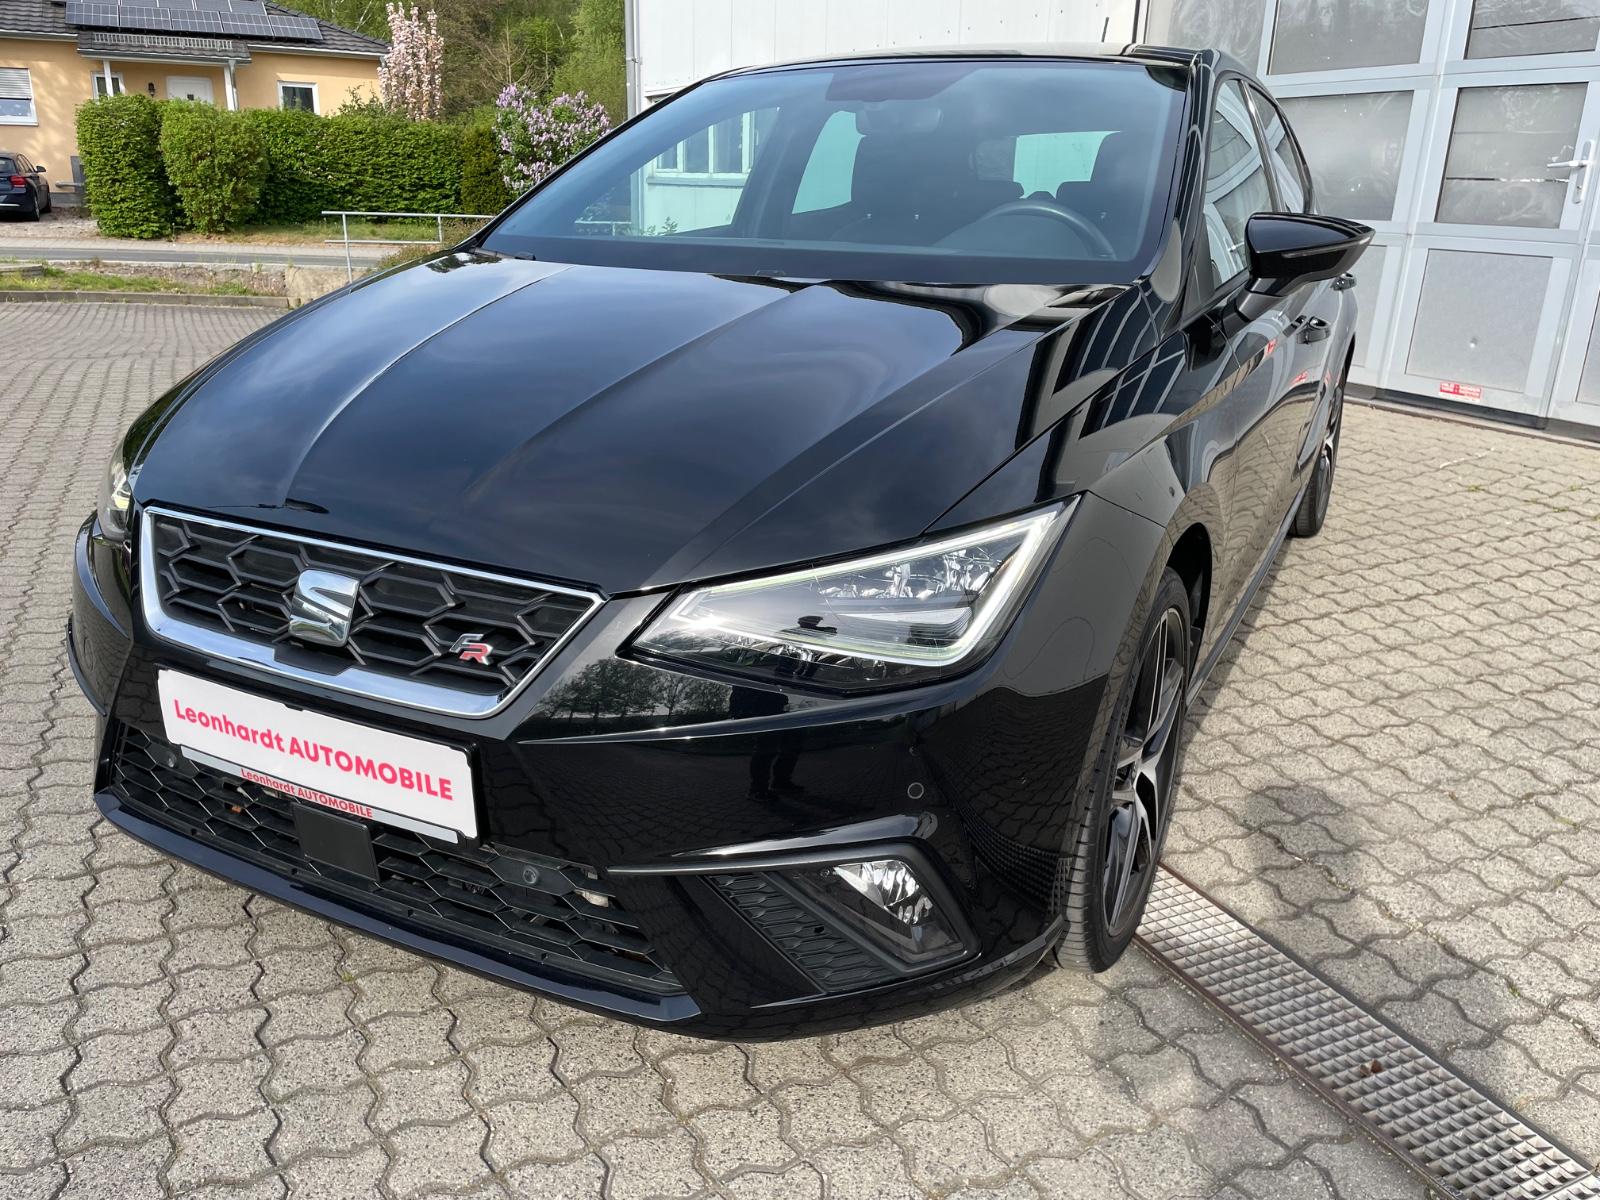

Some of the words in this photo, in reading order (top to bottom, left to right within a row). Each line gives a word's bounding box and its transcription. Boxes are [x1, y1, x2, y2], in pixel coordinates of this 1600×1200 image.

[450, 633, 492, 665] FR
[174, 700, 286, 752] Leonhardt
[289, 737, 453, 800] AUTOMOBILE
[241, 768, 295, 794] Leonhardt
[297, 788, 373, 818] AUTOMOBILE
